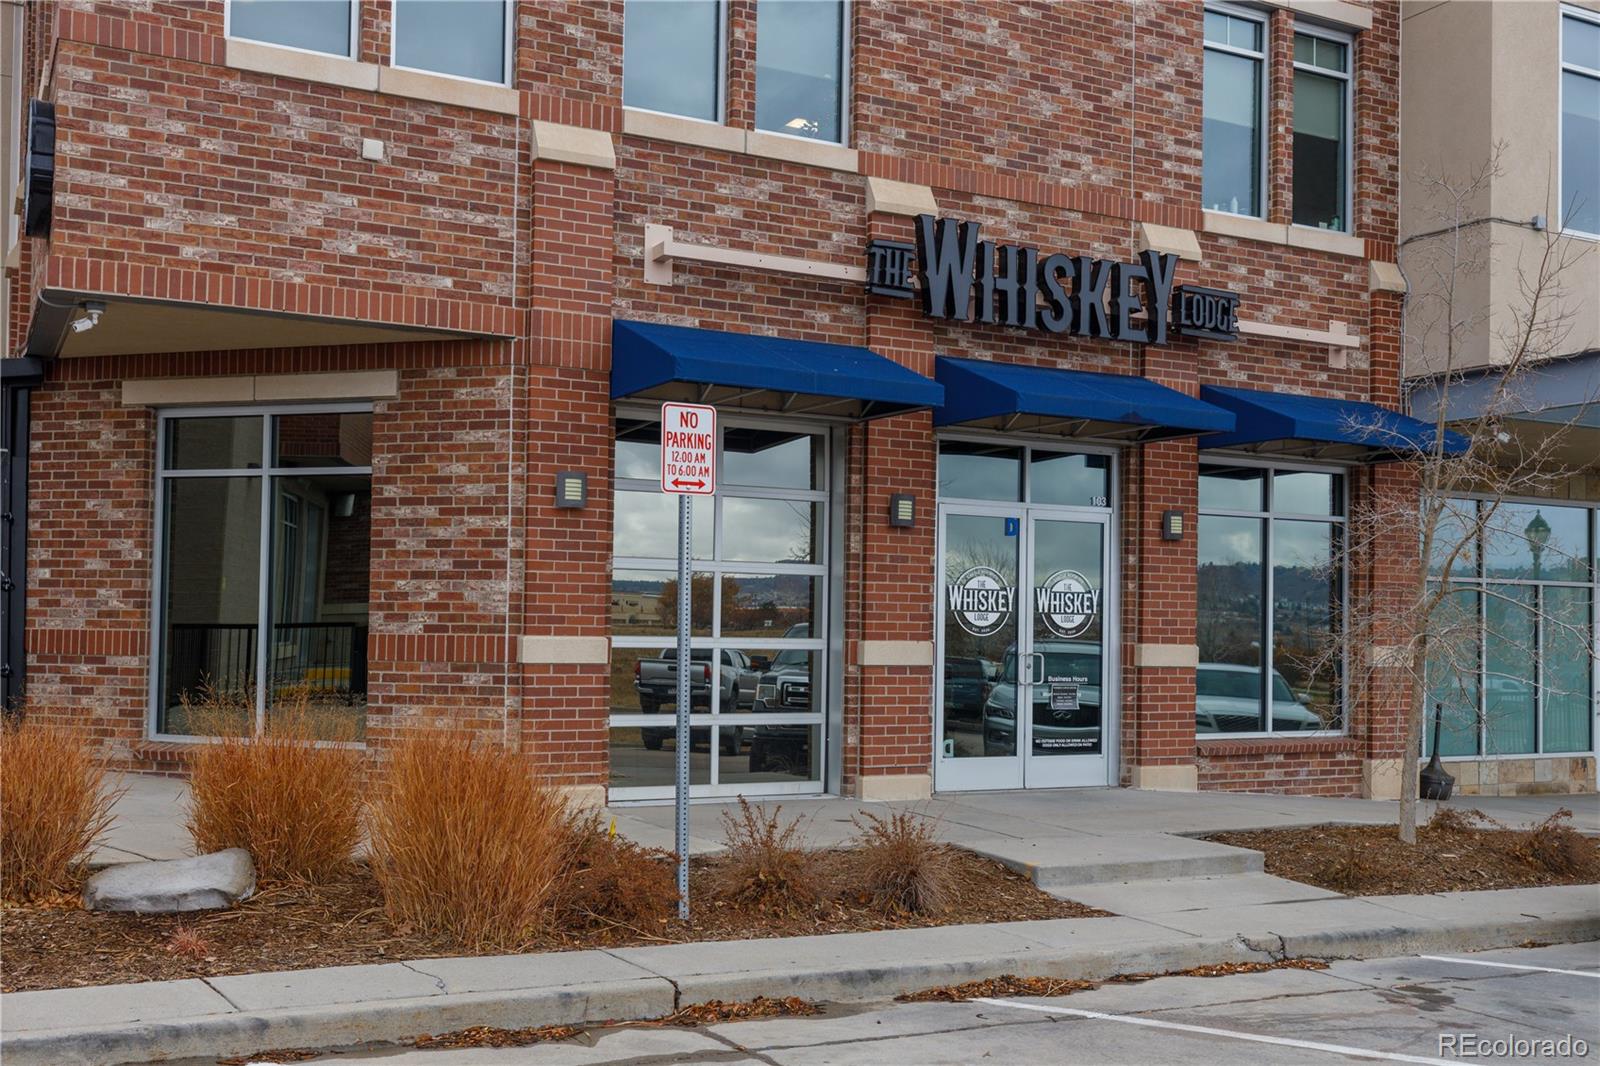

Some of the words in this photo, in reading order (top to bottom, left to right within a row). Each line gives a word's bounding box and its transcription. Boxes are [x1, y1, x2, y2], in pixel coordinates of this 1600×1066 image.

[873, 246, 916, 290] THE
[913, 214, 1180, 345] WHISKEY
[1180, 292, 1239, 333] LODGE
[680, 411, 699, 429] NO
[666, 431, 711, 450] PARKING
[672, 451, 692, 463] 12:00
[694, 453, 706, 464] AM
[667, 464, 676, 476] TO
[678, 465, 696, 477] 6:00
[698, 466, 710, 478] AM
[977, 580, 986, 588] THE
[949, 585, 1016, 612] WHISKEY
[1037, 588, 1099, 614] WHISKEY
[973, 612, 990, 621] LODGE
[1060, 615, 1075, 624] LODGE
